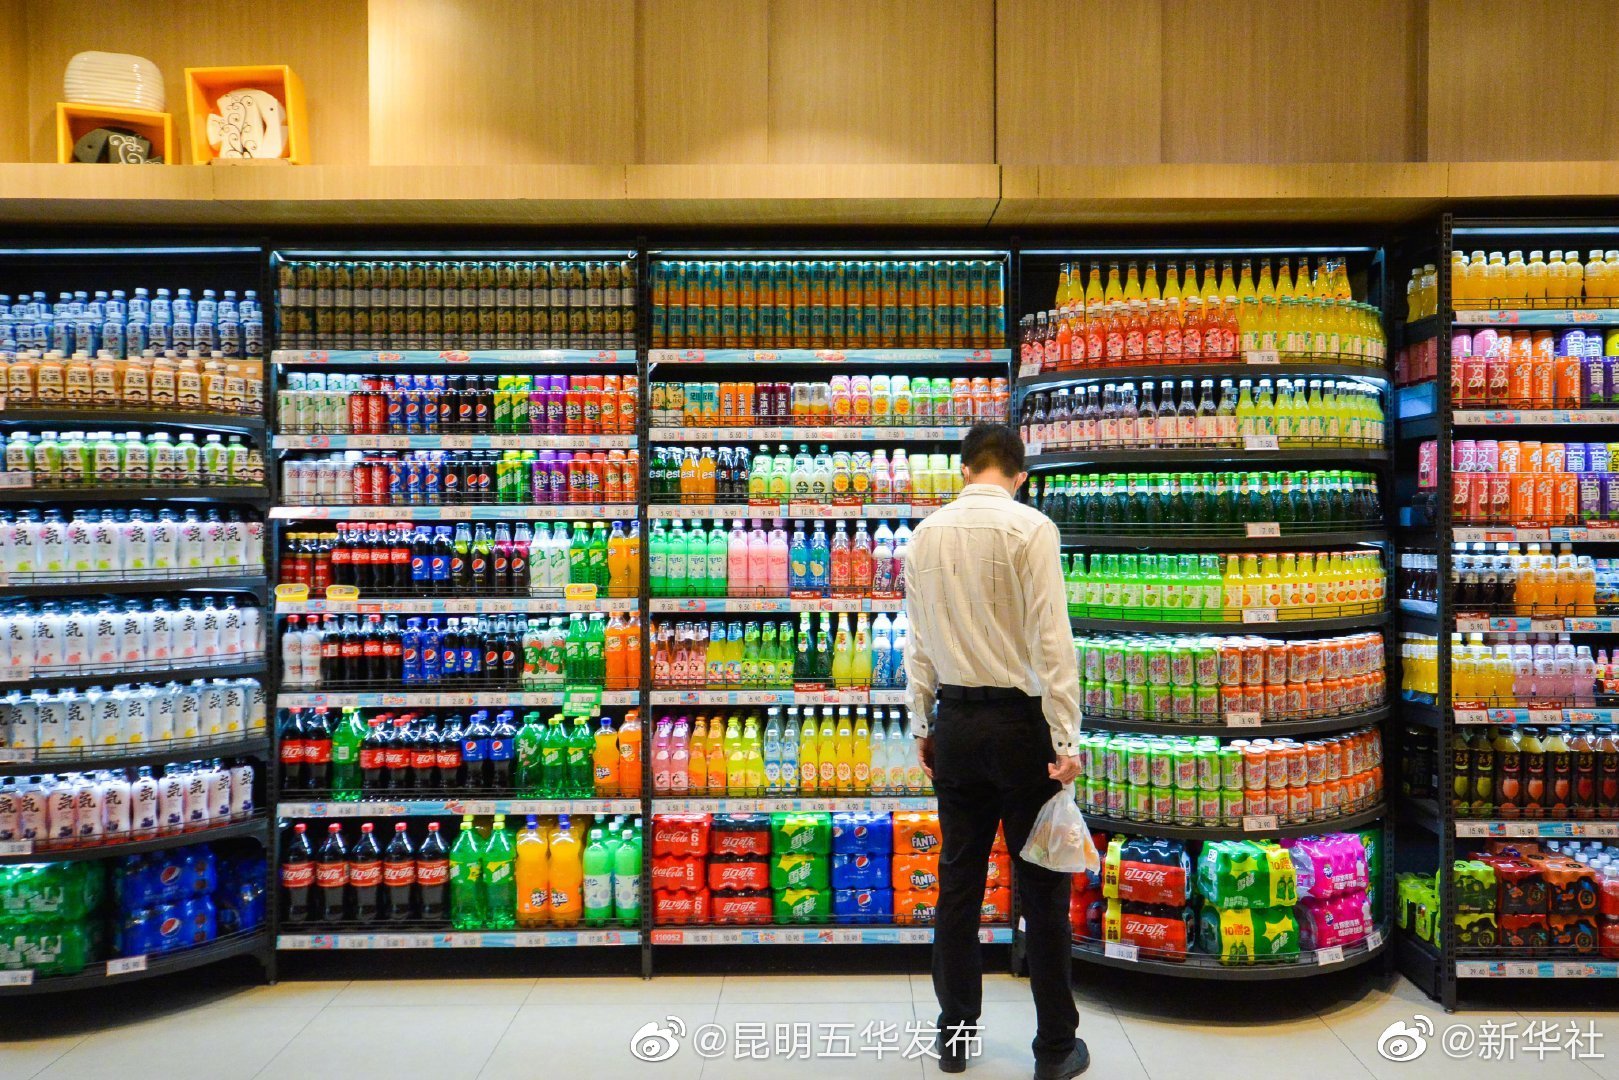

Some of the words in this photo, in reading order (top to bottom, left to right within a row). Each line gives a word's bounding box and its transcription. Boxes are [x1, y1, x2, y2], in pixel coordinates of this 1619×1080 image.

[681, 470, 694, 479] est
[722, 837, 756, 848] 可口可乐
[790, 828, 815, 849] 雪碧
[912, 836, 938, 847] FANTA
[722, 867, 756, 879] 可口可乐
[788, 863, 812, 884] 雪碧
[1124, 868, 1168, 882] 可口可乐
[910, 874, 936, 886] FANTA
[658, 899, 692, 910] 可口可乐
[723, 902, 758, 913] 可口可乐
[1126, 921, 1168, 935] 可口可乐
[654, 933, 680, 941] 110052
